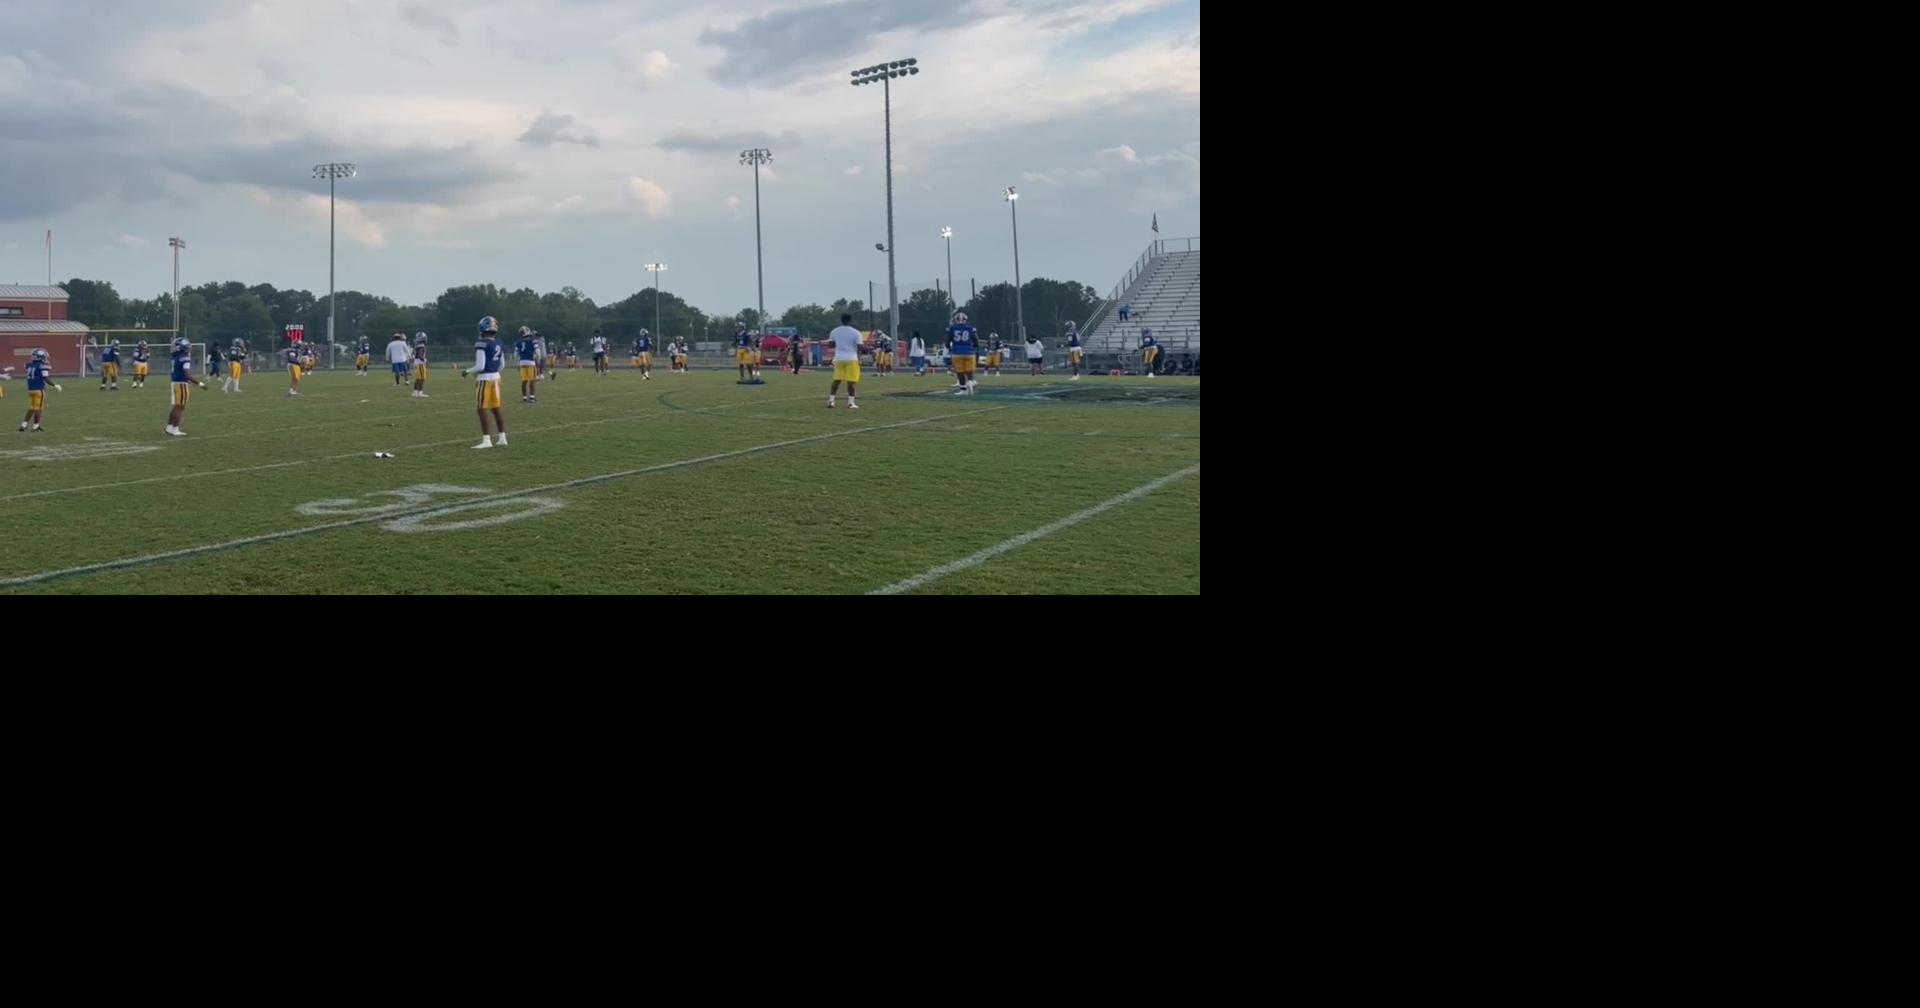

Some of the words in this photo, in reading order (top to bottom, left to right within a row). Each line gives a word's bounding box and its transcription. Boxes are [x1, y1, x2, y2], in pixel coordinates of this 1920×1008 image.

[953, 330, 969, 342] 58
[493, 345, 501, 361] 2
[295, 483, 565, 532] 50
